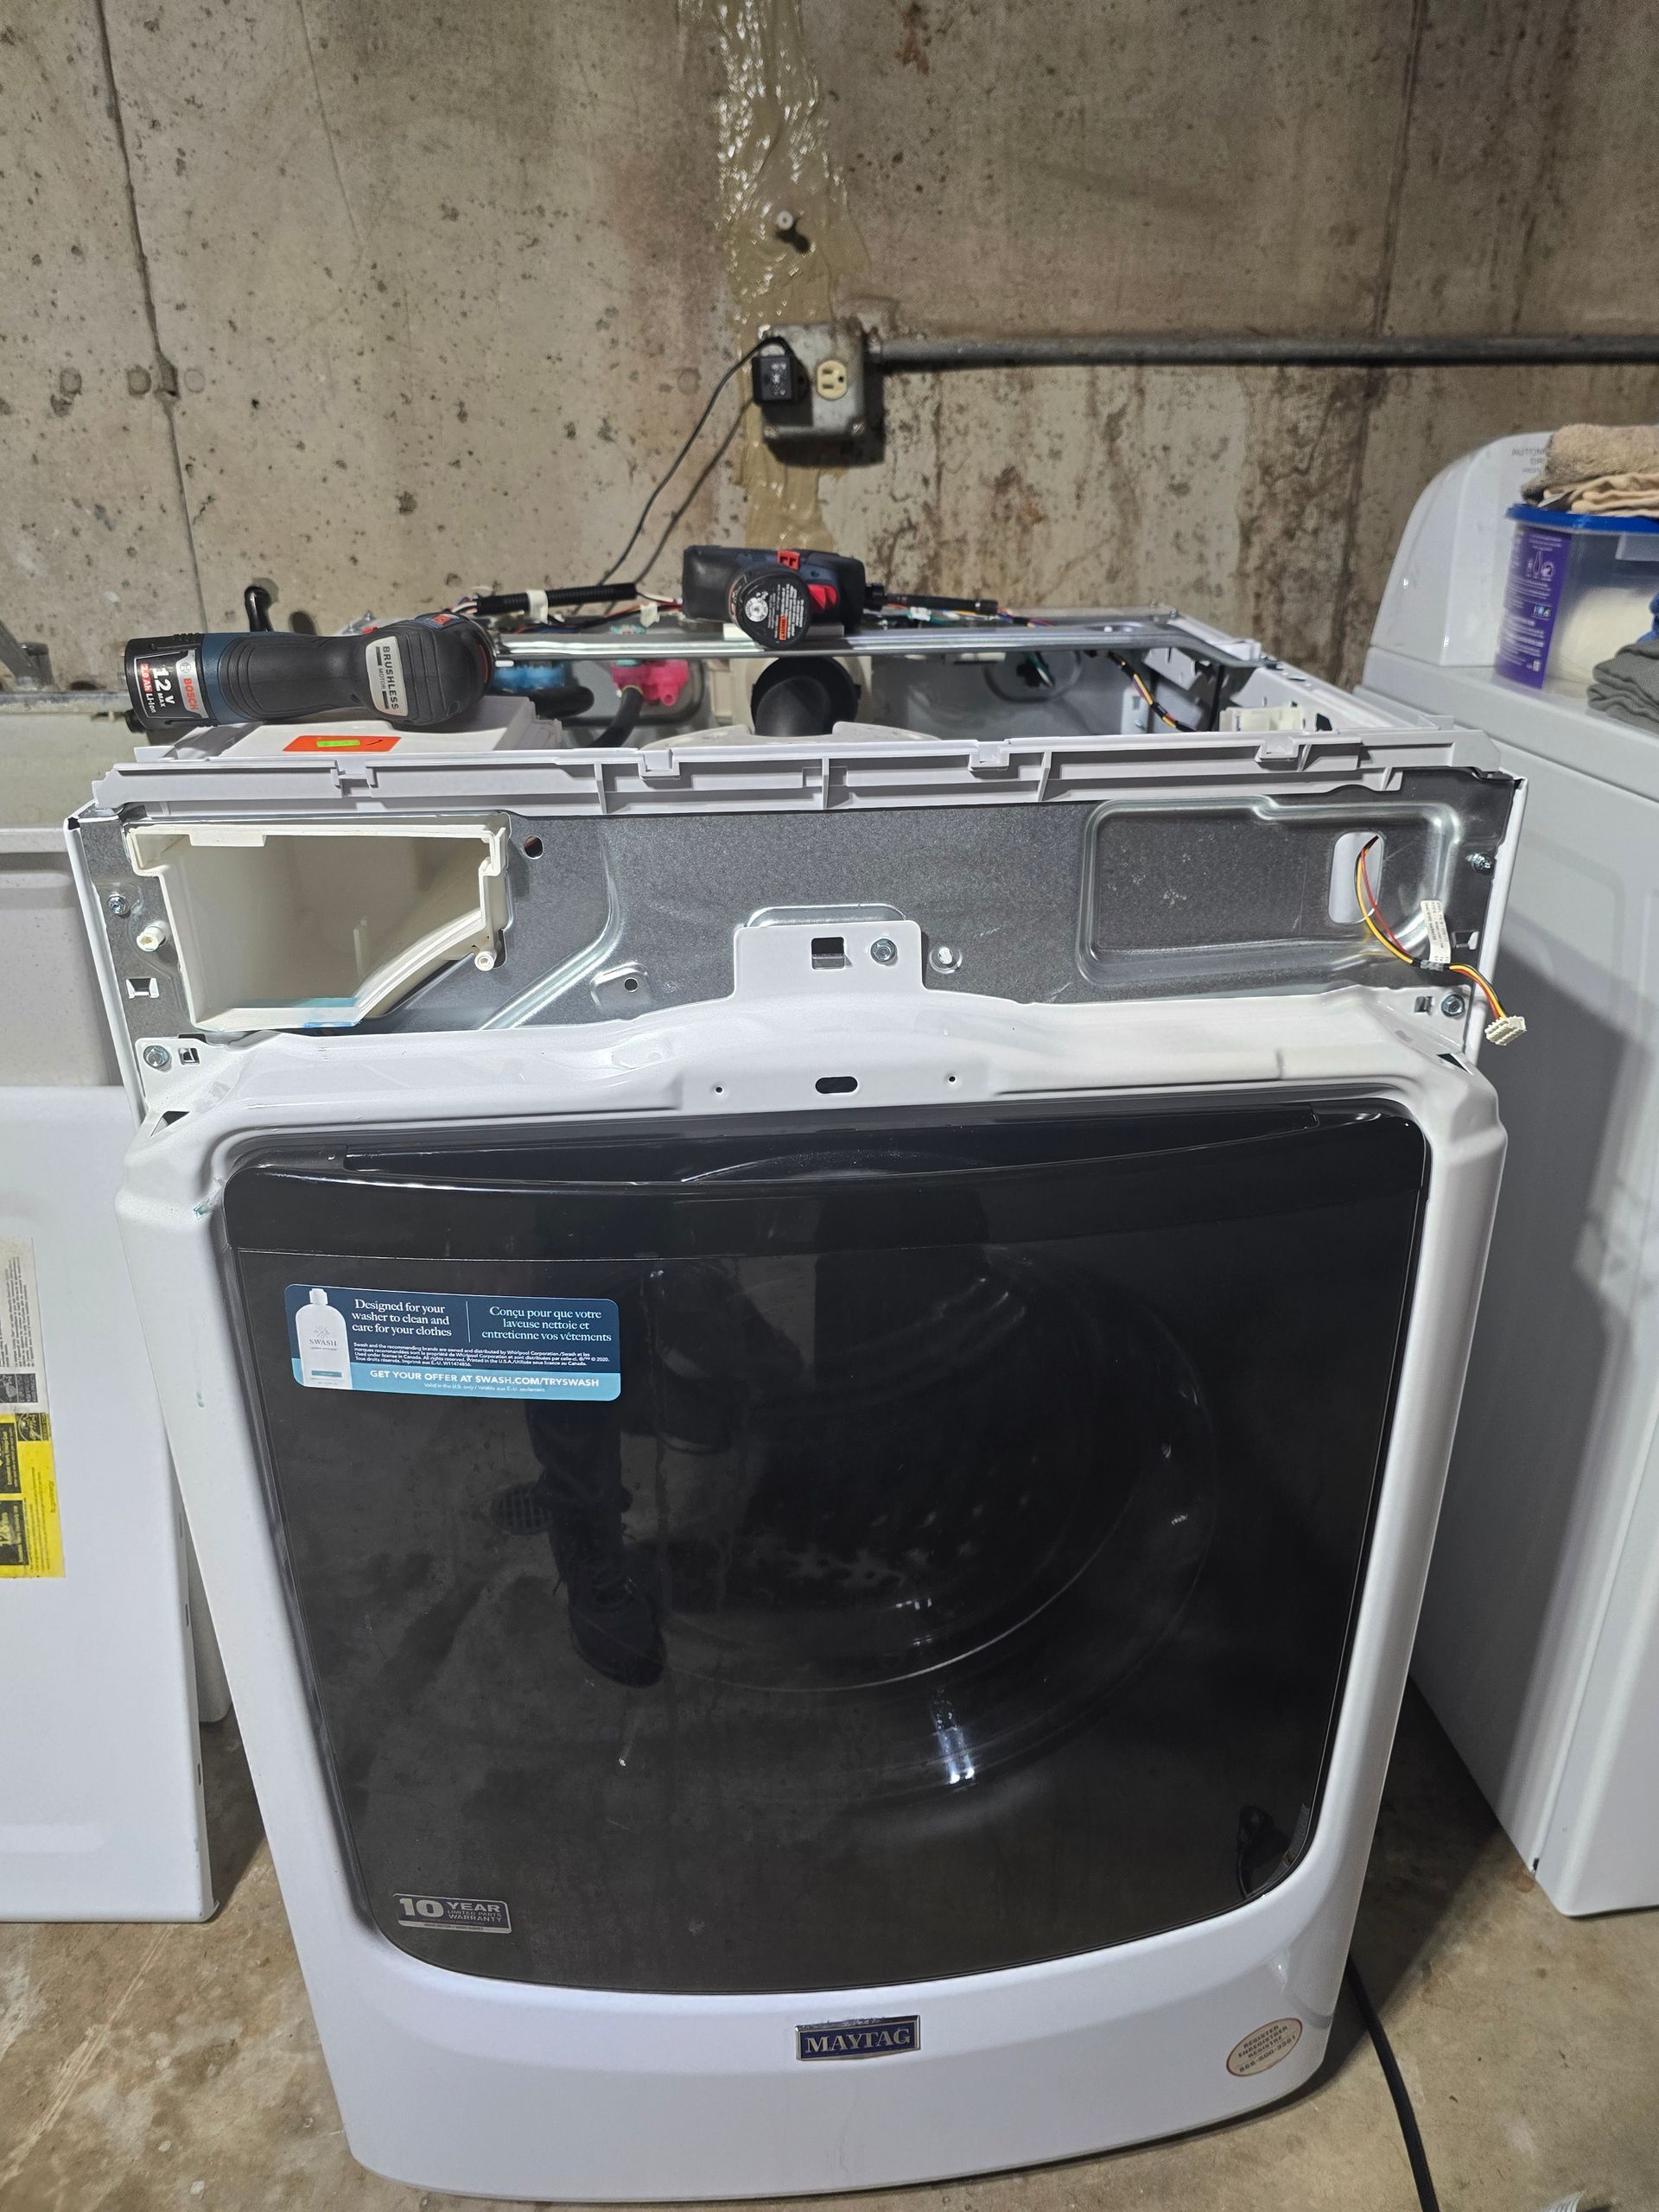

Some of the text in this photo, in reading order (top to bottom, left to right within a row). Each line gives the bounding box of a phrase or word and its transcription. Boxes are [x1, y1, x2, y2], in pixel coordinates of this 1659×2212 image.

[383, 646, 399, 709] BRUSHLESS
[143, 678, 152, 692] Ah
[153, 668, 175, 704] 12 V
[157, 693, 166, 707] MAX
[183, 678, 198, 710] BOSCH
[355, 1299, 445, 1315] Designed for your
[489, 1306, 602, 1320] Conçu pour que votre
[352, 1312, 388, 1322] washer
[402, 1314, 428, 1324] clean
[431, 1316, 450, 1325] and
[503, 1319, 540, 1328] laveuse
[542, 1320, 577, 1329] nettoie
[352, 1324, 452, 1337] care for your clothes
[482, 1330, 540, 1340] entretienne
[560, 1332, 612, 1341] vêtements
[370, 1370, 390, 1378] GET
[392, 1371, 422, 1380] YOUR
[424, 1373, 458, 1382] OFFER
[475, 1375, 599, 1387] SWASH.COM/TRYSWASH
[399, 1897, 500, 1918] 10 YEAR
[448, 1914, 502, 1923] WARRANTY
[805, 2028, 911, 2053] MAYTAG
